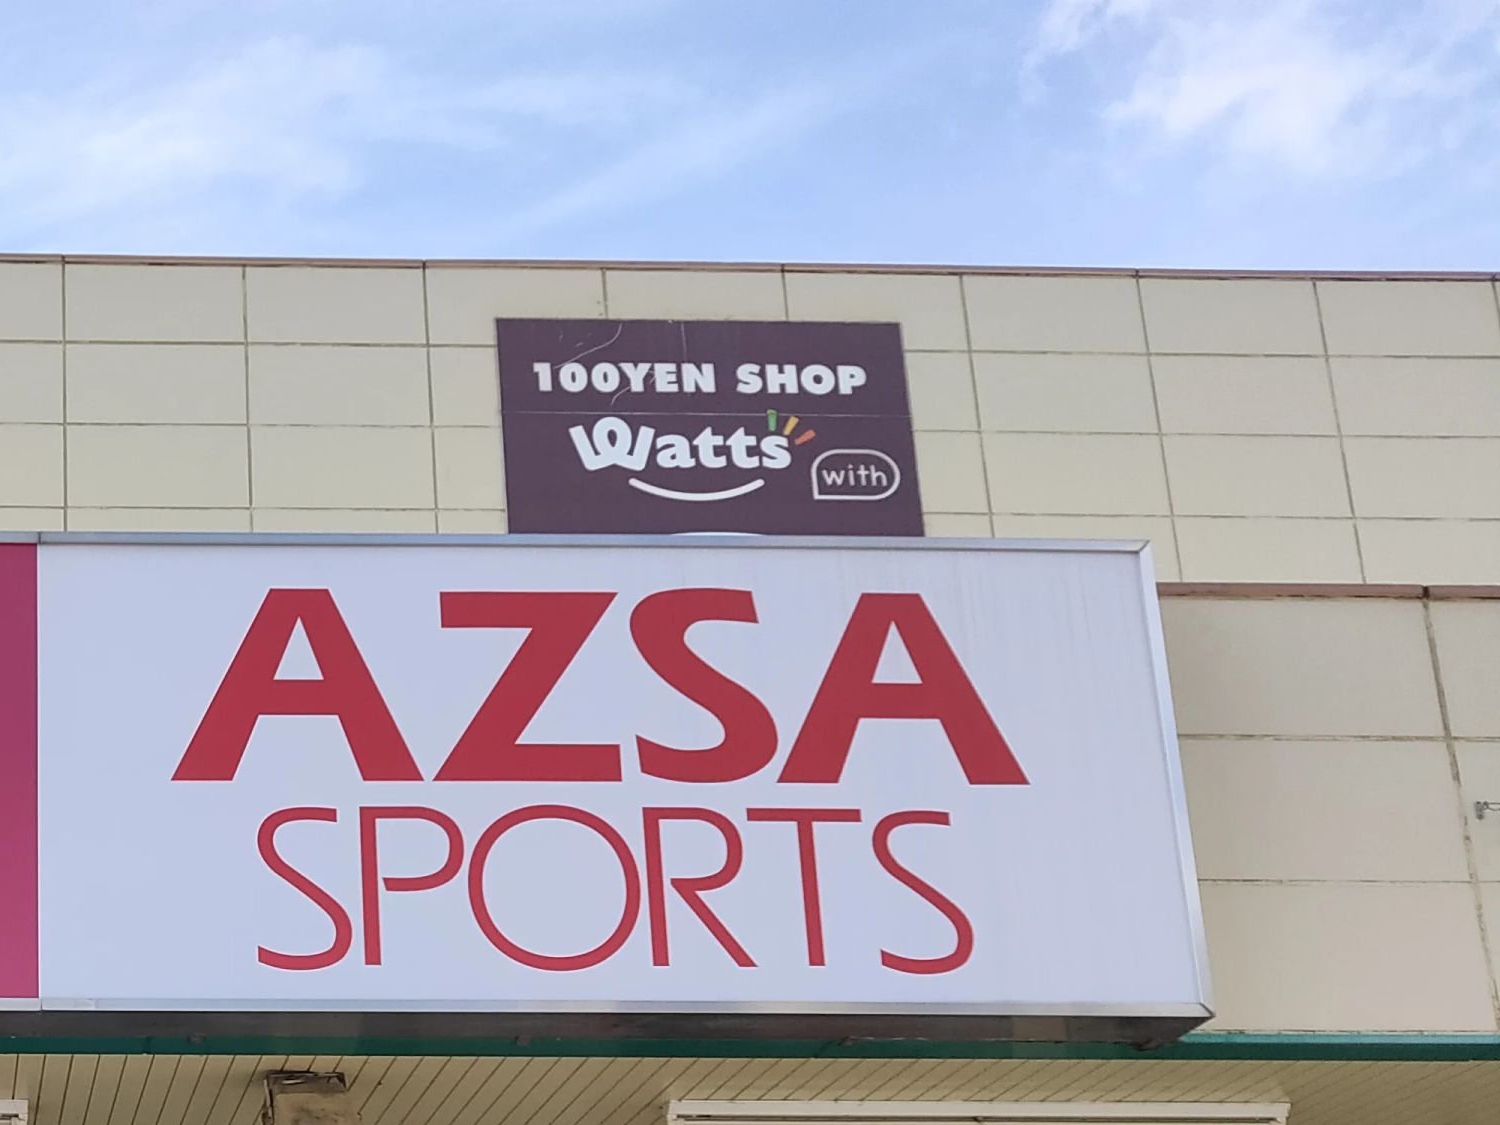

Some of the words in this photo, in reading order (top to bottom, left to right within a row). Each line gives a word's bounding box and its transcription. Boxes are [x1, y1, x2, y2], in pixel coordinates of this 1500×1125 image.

[533, 361, 716, 394] 100YEN
[736, 363, 867, 395] SHOP
[568, 416, 792, 471] Watts
[822, 464, 888, 489] with
[171, 588, 1030, 785] AZSA
[256, 804, 974, 975] SPORTS
